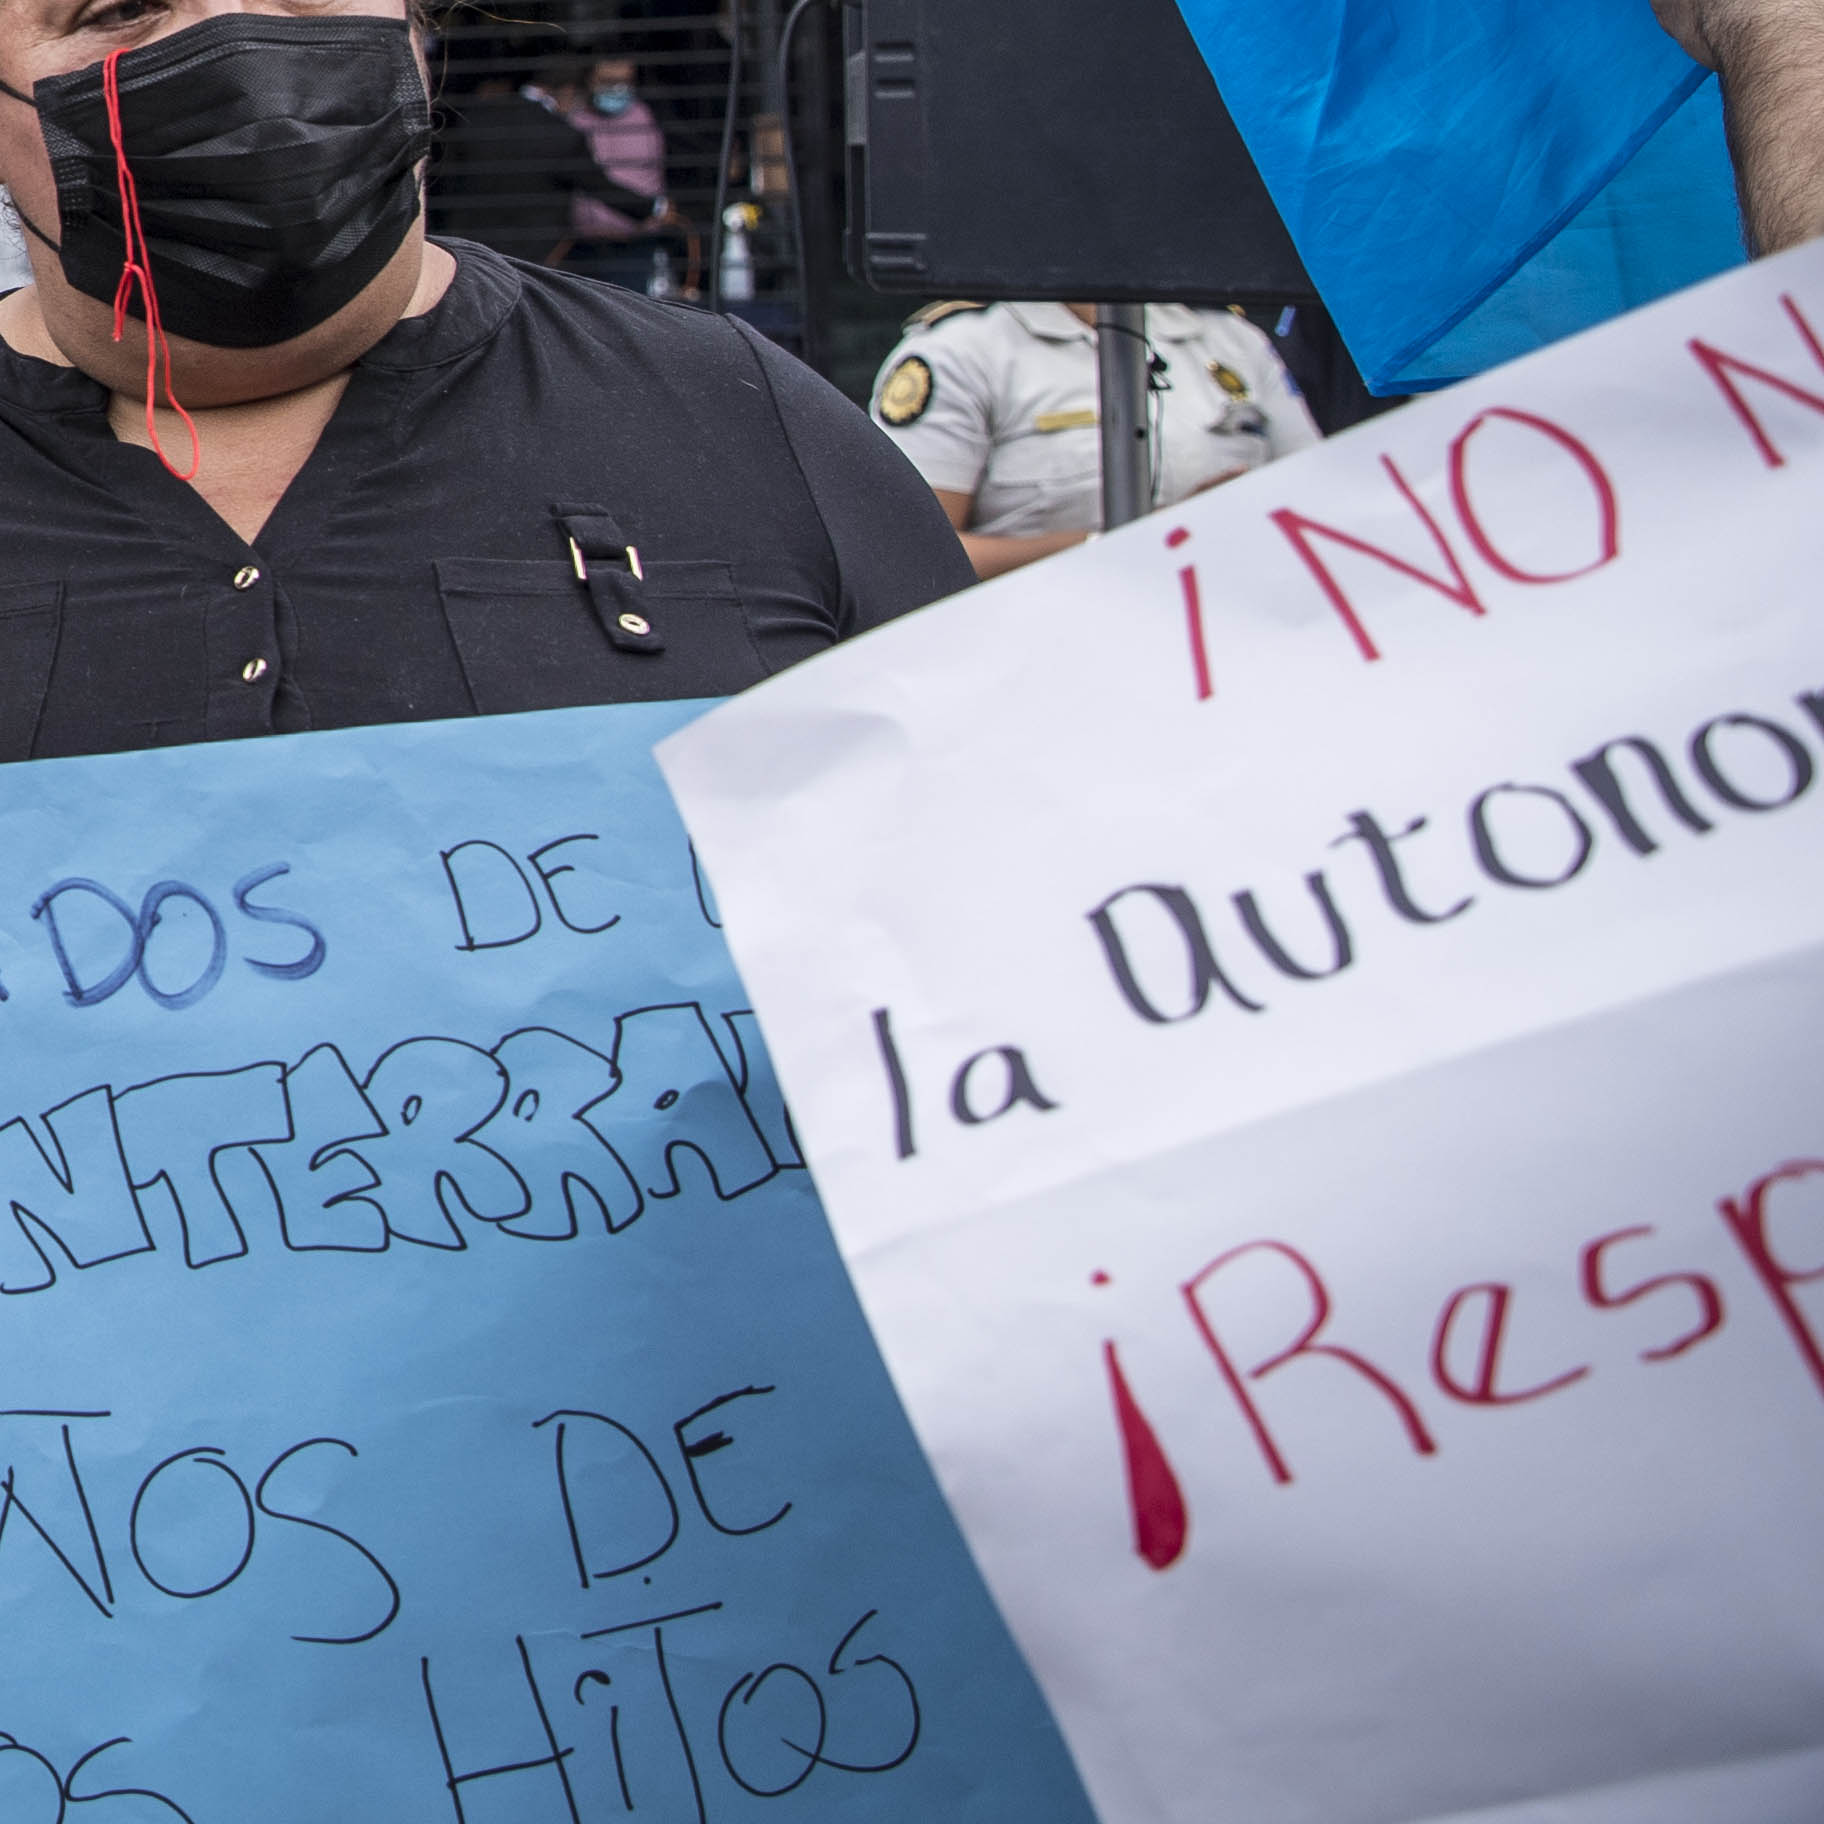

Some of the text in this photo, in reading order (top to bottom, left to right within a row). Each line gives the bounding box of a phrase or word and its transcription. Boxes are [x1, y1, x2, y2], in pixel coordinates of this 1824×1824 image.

[443, 833, 621, 951] DE
[870, 688, 1824, 1161] la autono
[532, 1386, 792, 1588] DE
